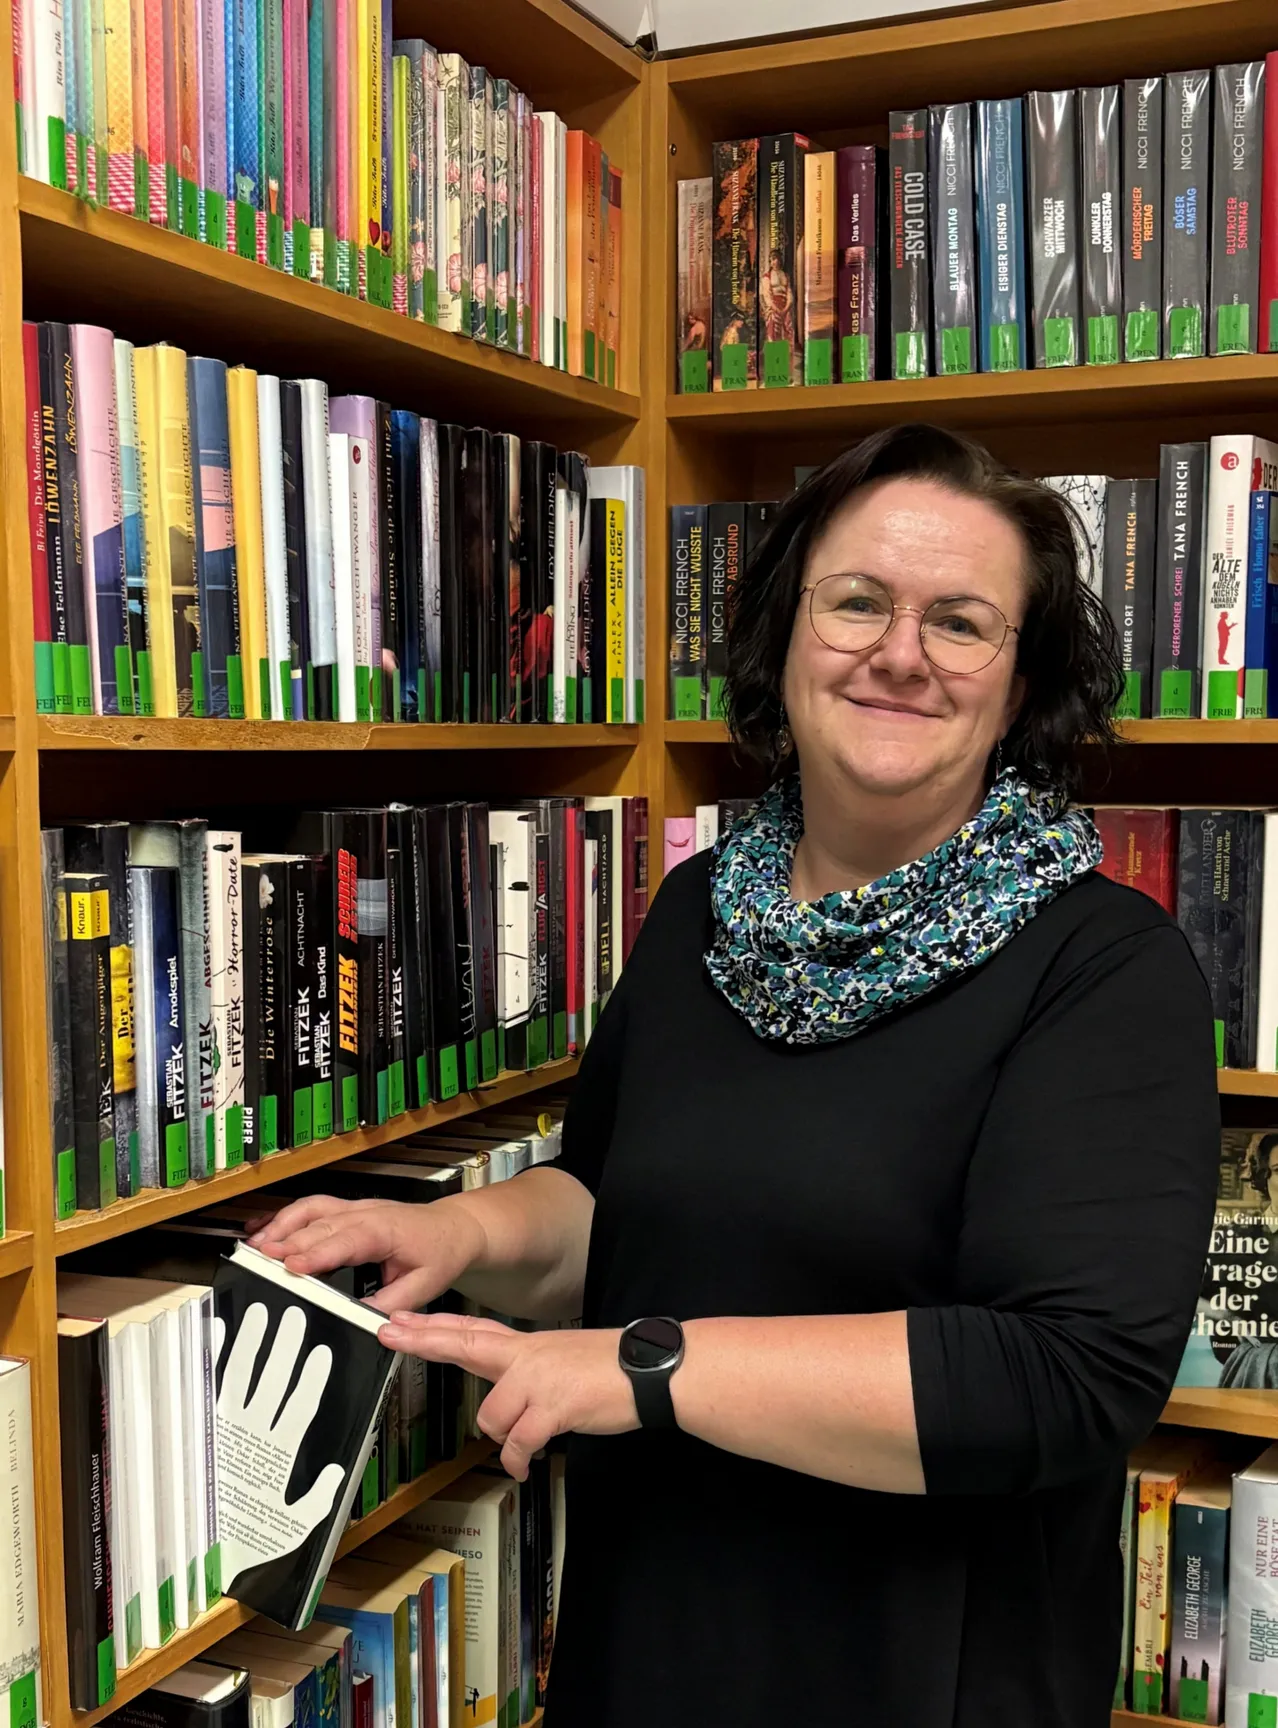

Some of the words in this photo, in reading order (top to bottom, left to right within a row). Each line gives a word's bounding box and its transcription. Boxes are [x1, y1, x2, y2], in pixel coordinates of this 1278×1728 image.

[1137, 86, 1148, 132] FRENCH
[1181, 78, 1194, 129] FRENCH
[1233, 78, 1246, 129] FRENCH
[945, 117, 956, 161] FRENCH
[994, 114, 1006, 157] FRENCH
[1137, 136, 1148, 169] NICCI
[1180, 134, 1192, 170] NICCI
[1233, 134, 1245, 171] NICCI
[894, 167, 902, 179] DAS
[904, 172, 924, 213] COLD
[946, 164, 957, 196] NICCI
[996, 159, 1006, 194] NICCI
[851, 193, 860, 223] Verlies
[997, 203, 1008, 250] DIENSTAG
[1043, 198, 1055, 258] SCHWARZER
[1054, 200, 1065, 254] MITTWOCH
[1091, 202, 1102, 245] DUNKLER
[1102, 192, 1113, 253] DONNERSTAG
[1131, 187, 1143, 259] MÖRDERISCHER
[1143, 204, 1154, 241] FREITAG
[1173, 196, 1185, 229] BÖSER
[1186, 188, 1197, 235] SAMSTAG
[1226, 197, 1237, 254] BLUTROTER
[1238, 201, 1249, 249] SONNTAG
[851, 225, 859, 242] Das
[904, 220, 925, 259] CASE
[948, 208, 958, 250] MONTAG
[850, 274, 860, 308] Franz
[949, 252, 959, 291] BLAUER
[998, 254, 1008, 291] EISIGER
[63, 353, 78, 454] LÖWENZAHN
[31, 410, 43, 482] Mondgöttin
[42, 405, 61, 523] LÖWENZAHN
[1176, 461, 1188, 516] FRENCH
[1264, 462, 1277, 490] DER
[35, 488, 43, 506] Die
[1126, 512, 1136, 556] FRENCH
[1174, 523, 1186, 561] TANA
[1253, 516, 1265, 540] faber
[351, 491, 362, 618] FEUCHTWANGER
[676, 539, 689, 596] FRENCH
[691, 526, 702, 574] WUSSTE
[713, 537, 725, 595] FRENCH
[727, 524, 739, 581] ABGRUND
[1212, 559, 1242, 573] ALTE
[1253, 550, 1264, 571] Homo
[53, 536, 66, 612] Feldmann
[690, 577, 701, 611] NICHT
[1125, 559, 1135, 591] TANA
[1174, 567, 1183, 596] SCHREI
[1212, 581, 1240, 589] KUGELN
[1214, 589, 1239, 597] NICHTS
[1219, 573, 1236, 581] DEM
[1252, 577, 1265, 608] Frisch
[56, 616, 66, 644] Else
[675, 602, 689, 644] NICCI
[690, 616, 701, 633] SIE
[712, 601, 725, 643] NICCI
[1124, 605, 1133, 627] ORT
[1172, 601, 1181, 656] GEFRORENER
[690, 636, 701, 662] WAS
[1123, 630, 1133, 671] HEIMER
[1212, 708, 1234, 716] FRIE
[1214, 854, 1223, 879] Hauch
[338, 848, 351, 939] SCHREIB
[76, 898, 86, 934] Knaur.
[297, 890, 305, 967] ACHTNACHT
[264, 916, 275, 1022] Winterrose
[317, 946, 326, 974] Kind
[167, 956, 179, 1028] Amokspiel
[317, 976, 327, 999] Das
[338, 953, 354, 1052] FITZEK
[392, 966, 403, 1036] FITZEK
[538, 953, 548, 1013] FITZEK
[117, 1009, 128, 1038] Der
[230, 996, 242, 1067] FITZEK
[264, 1028, 275, 1060] Die
[298, 986, 310, 1065] FITZEK
[319, 1010, 331, 1078] FITZEK
[198, 1013, 213, 1108] FITZEK
[313, 1025, 321, 1068] SEBASTIAN
[165, 1060, 174, 1108] SEBASTIAN
[170, 1042, 185, 1119] FITZEK
[242, 1107, 253, 1144] PIPER
[172, 1169, 189, 1181] FITZ
[228, 1149, 241, 1162] FITZ
[1208, 1229, 1269, 1254] Eine
[1205, 1258, 1278, 1289] rage
[1210, 1287, 1258, 1311] der
[1195, 1312, 1278, 1337] hemie
[7, 1408, 18, 1472] BELINDA
[89, 1452, 103, 1532] Fleischhauer
[10, 1484, 23, 1578] EDGEWORTH
[416, 1524, 437, 1535] HAT
[442, 1526, 481, 1537] SEINEN
[1256, 1516, 1268, 1546] EINE
[91, 1533, 105, 1590] Wolfram
[1138, 1557, 1154, 1589] Teil
[1154, 1545, 1164, 1568] uns
[1187, 1555, 1201, 1591] GEORGE
[1255, 1548, 1267, 1578] NUR
[16, 1580, 26, 1627] MARIA
[1184, 1593, 1199, 1640] ELIZABETH
[1249, 1609, 1267, 1663] ELIZABETH
[1265, 1617, 1278, 1658] GEORGE
